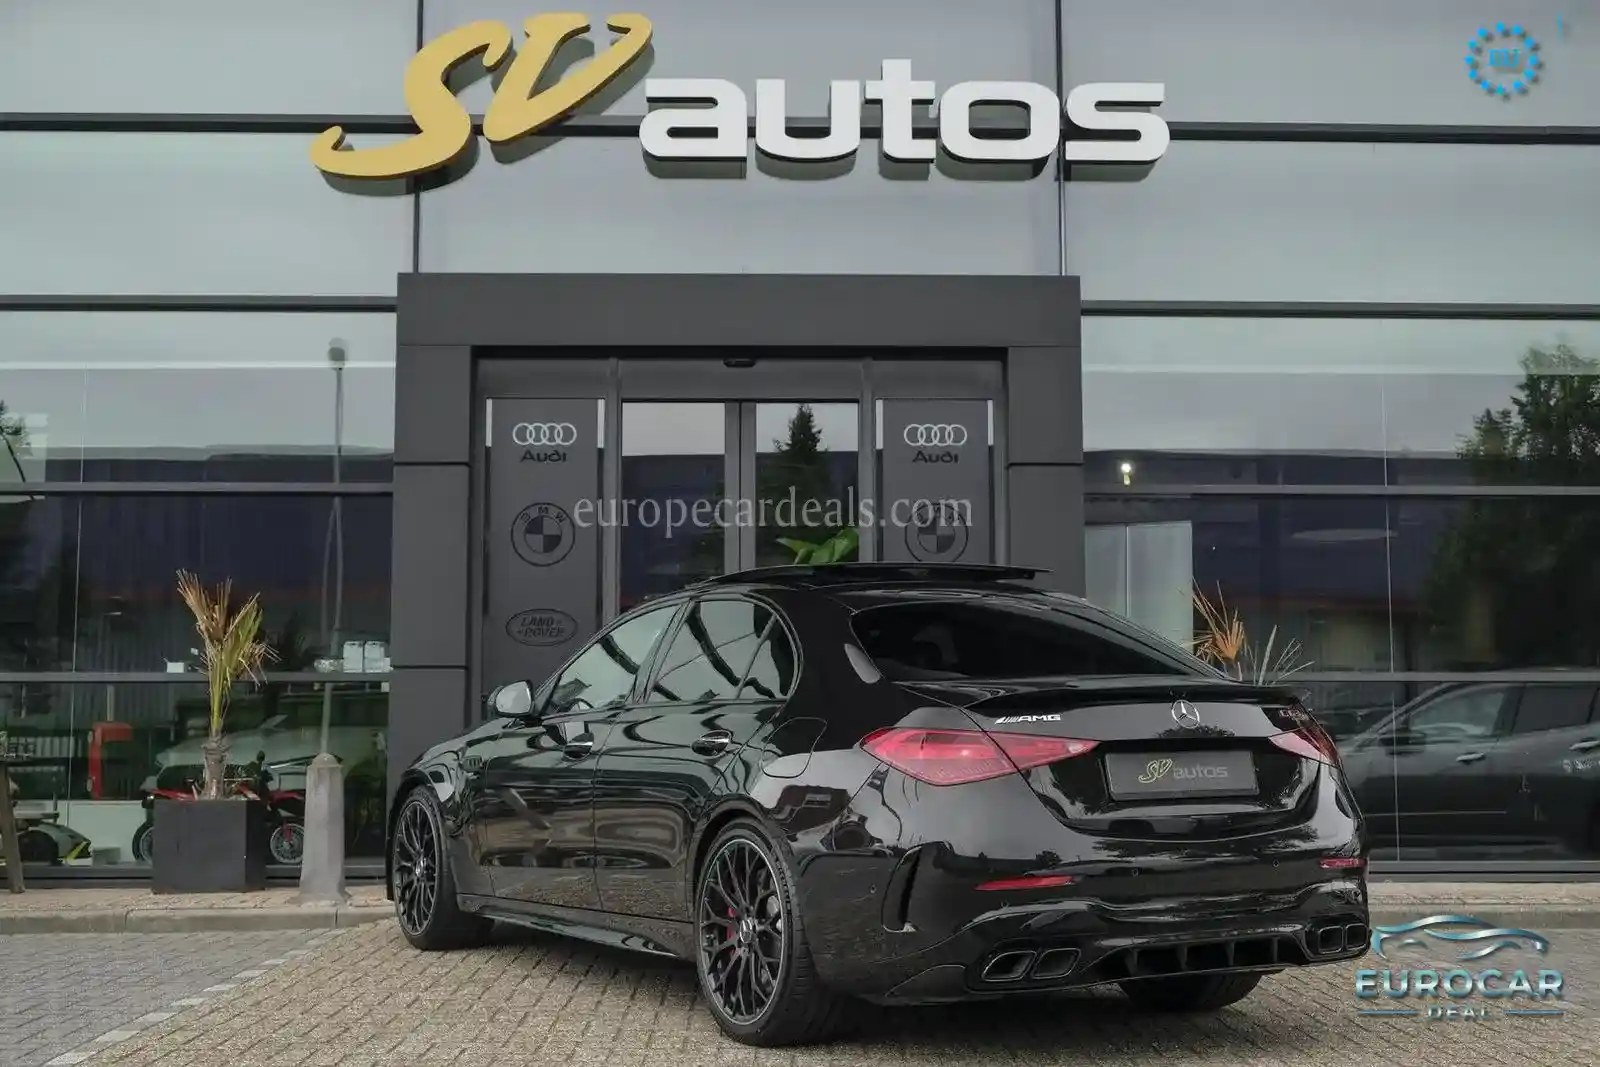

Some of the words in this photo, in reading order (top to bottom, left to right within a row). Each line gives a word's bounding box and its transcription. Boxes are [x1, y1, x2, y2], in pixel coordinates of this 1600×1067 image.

[638, 58, 1171, 164] autos
[519, 449, 567, 463] Audi
[911, 449, 959, 463] Audi
[1018, 714, 1062, 723] AMG
[1173, 763, 1230, 780] autos
